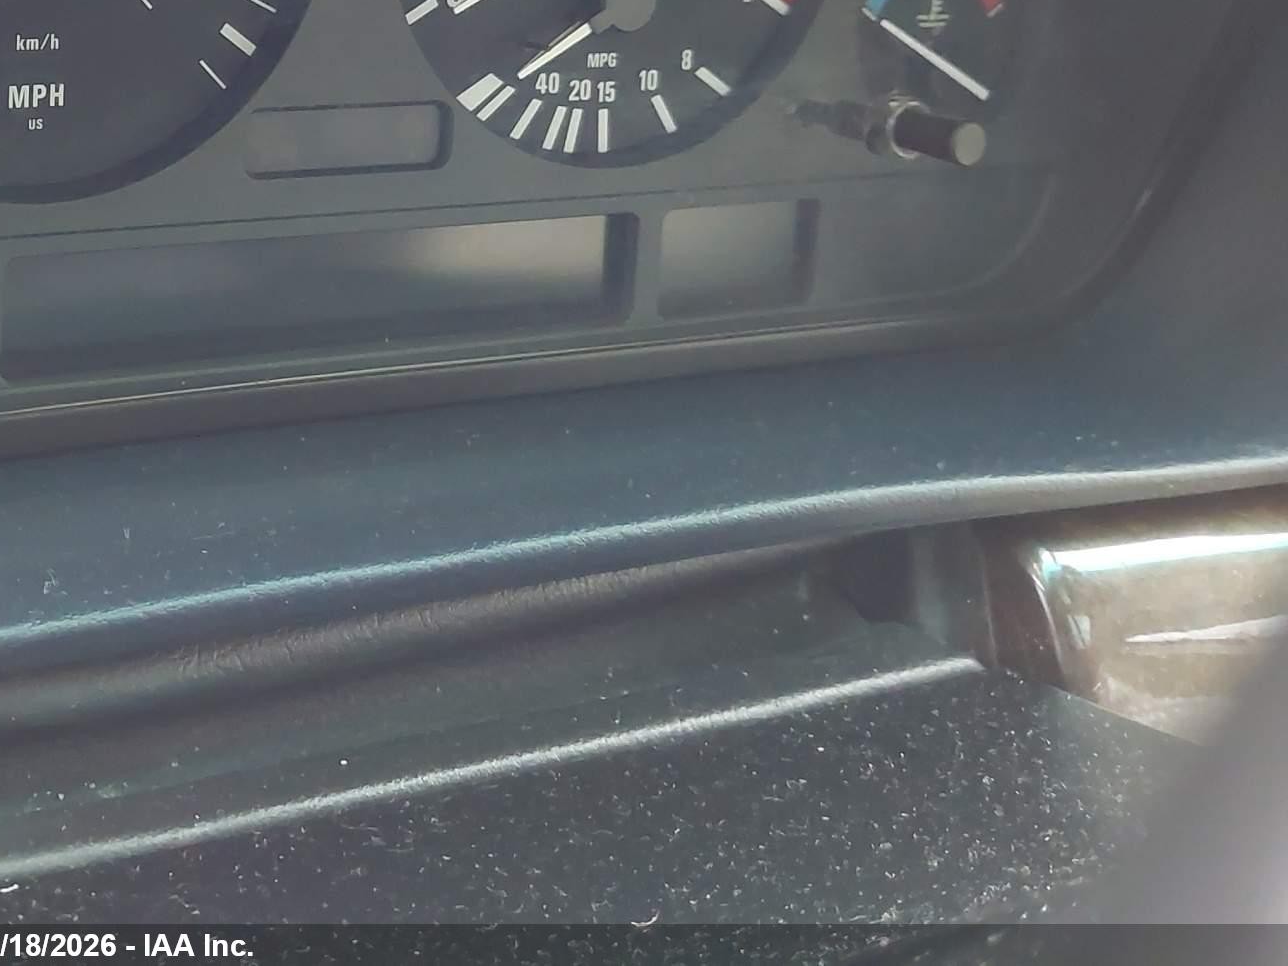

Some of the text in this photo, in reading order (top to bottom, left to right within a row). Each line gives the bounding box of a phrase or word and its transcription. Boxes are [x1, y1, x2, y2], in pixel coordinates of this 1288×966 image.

[15, 33, 60, 52] km/h
[586, 51, 617, 69] MPG
[681, 48, 693, 71] 8
[535, 71, 560, 95] 40
[569, 78, 592, 102] 20
[596, 79, 616, 103] 15
[638, 69, 658, 93] 10
[7, 84, 65, 109] MPH
[28, 117, 44, 131] US
